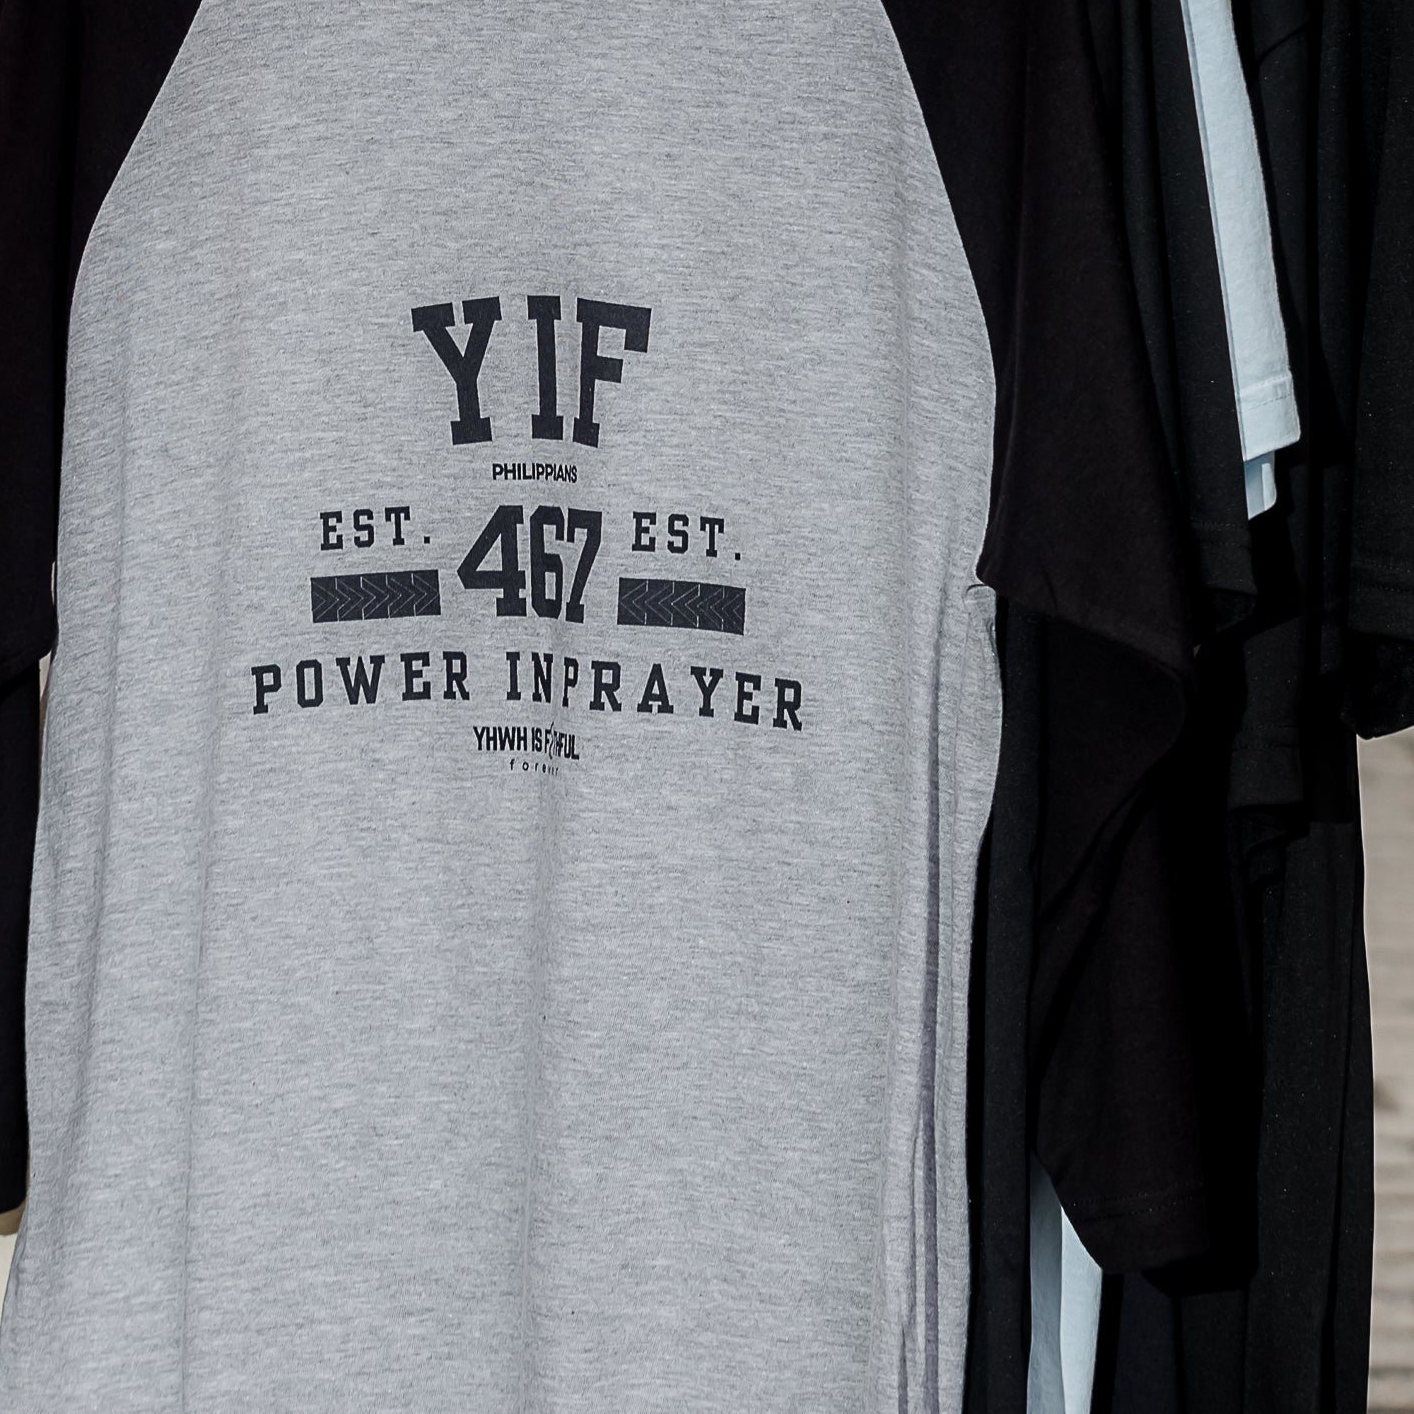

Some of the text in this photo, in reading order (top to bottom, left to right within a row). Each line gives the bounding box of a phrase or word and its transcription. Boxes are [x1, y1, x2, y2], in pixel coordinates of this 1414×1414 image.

[410, 294, 653, 449] YIF
[492, 462, 578, 484] PHILIPPIANS
[319, 504, 743, 624] EST. 467 EST.
[251, 651, 471, 715] POWER
[472, 725, 528, 752] YHWH
[531, 726, 543, 753] IS
